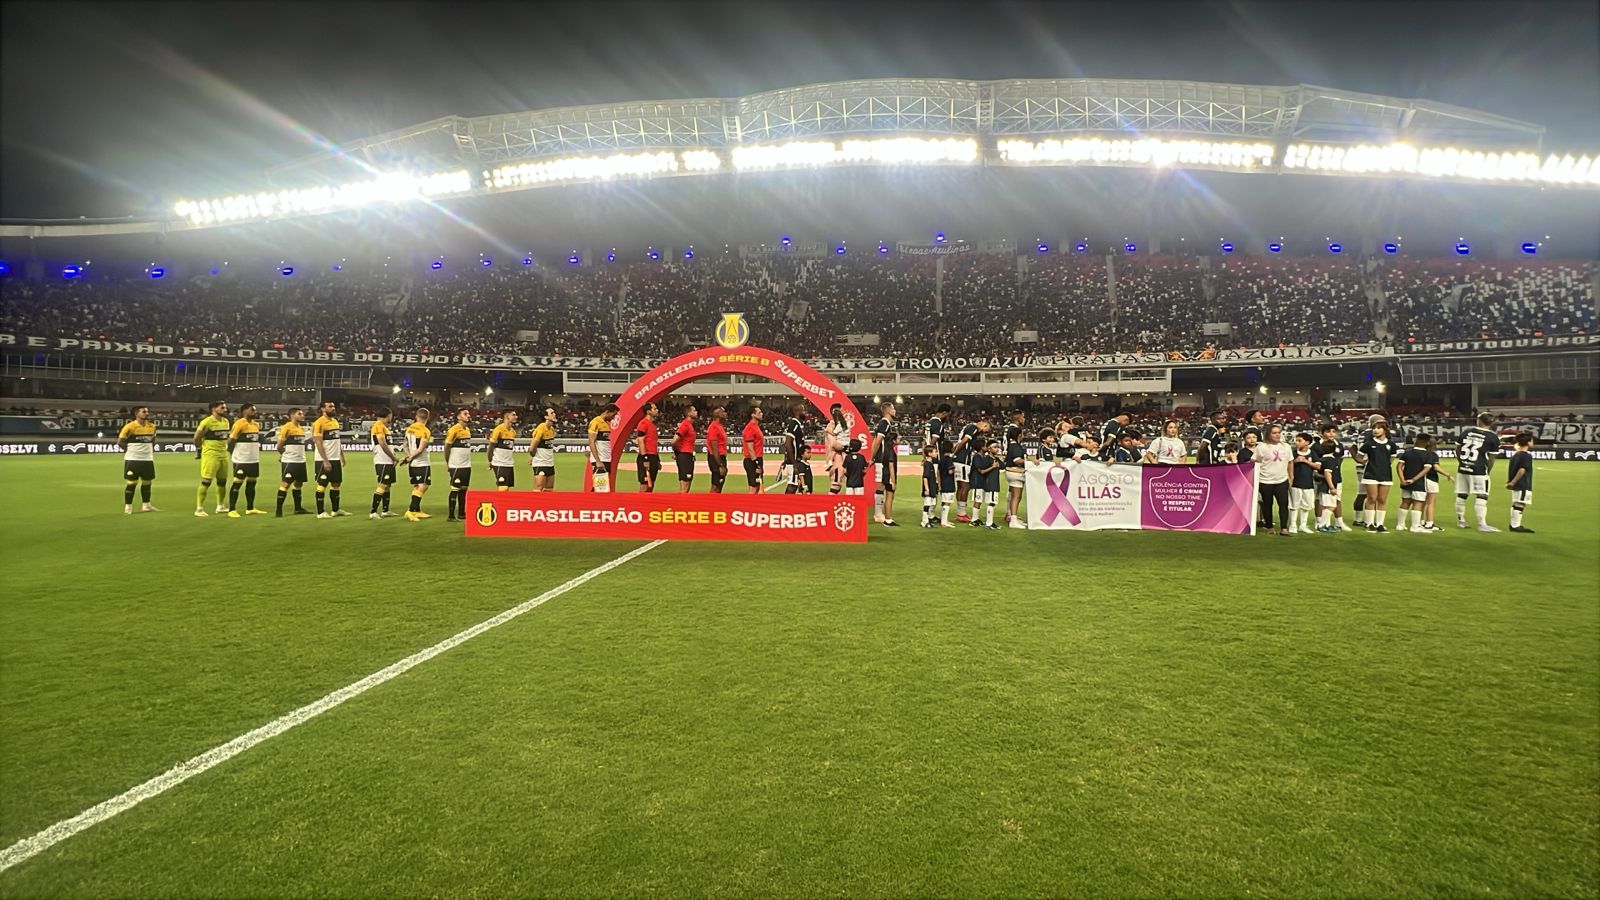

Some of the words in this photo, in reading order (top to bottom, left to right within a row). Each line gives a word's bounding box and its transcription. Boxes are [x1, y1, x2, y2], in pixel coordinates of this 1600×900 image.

[27, 336, 48, 346] E
[59, 338, 174, 354] PAIXÃO
[183, 346, 255, 359] PELO
[262, 350, 345, 361] CLUBE
[354, 352, 384, 362] DO
[391, 353, 449, 364] REMO
[1052, 353, 1162, 365] PIRATAS
[1225, 345, 1369, 359] AZULINOS
[634, 356, 715, 400] BRASILEIRÃO
[718, 354, 758, 364] SÉRIE
[760, 358, 770, 366] B
[774, 359, 836, 399] SUPERBET
[1460, 439, 1484, 461] 33
[1079, 474, 1134, 485] AGOSTO
[1078, 484, 1122, 499] LILÁS
[506, 507, 643, 523] BRASILEIRÃO
[649, 508, 710, 524] SÉRIE
[713, 511, 727, 524] B
[731, 510, 828, 528] SUPERBET
